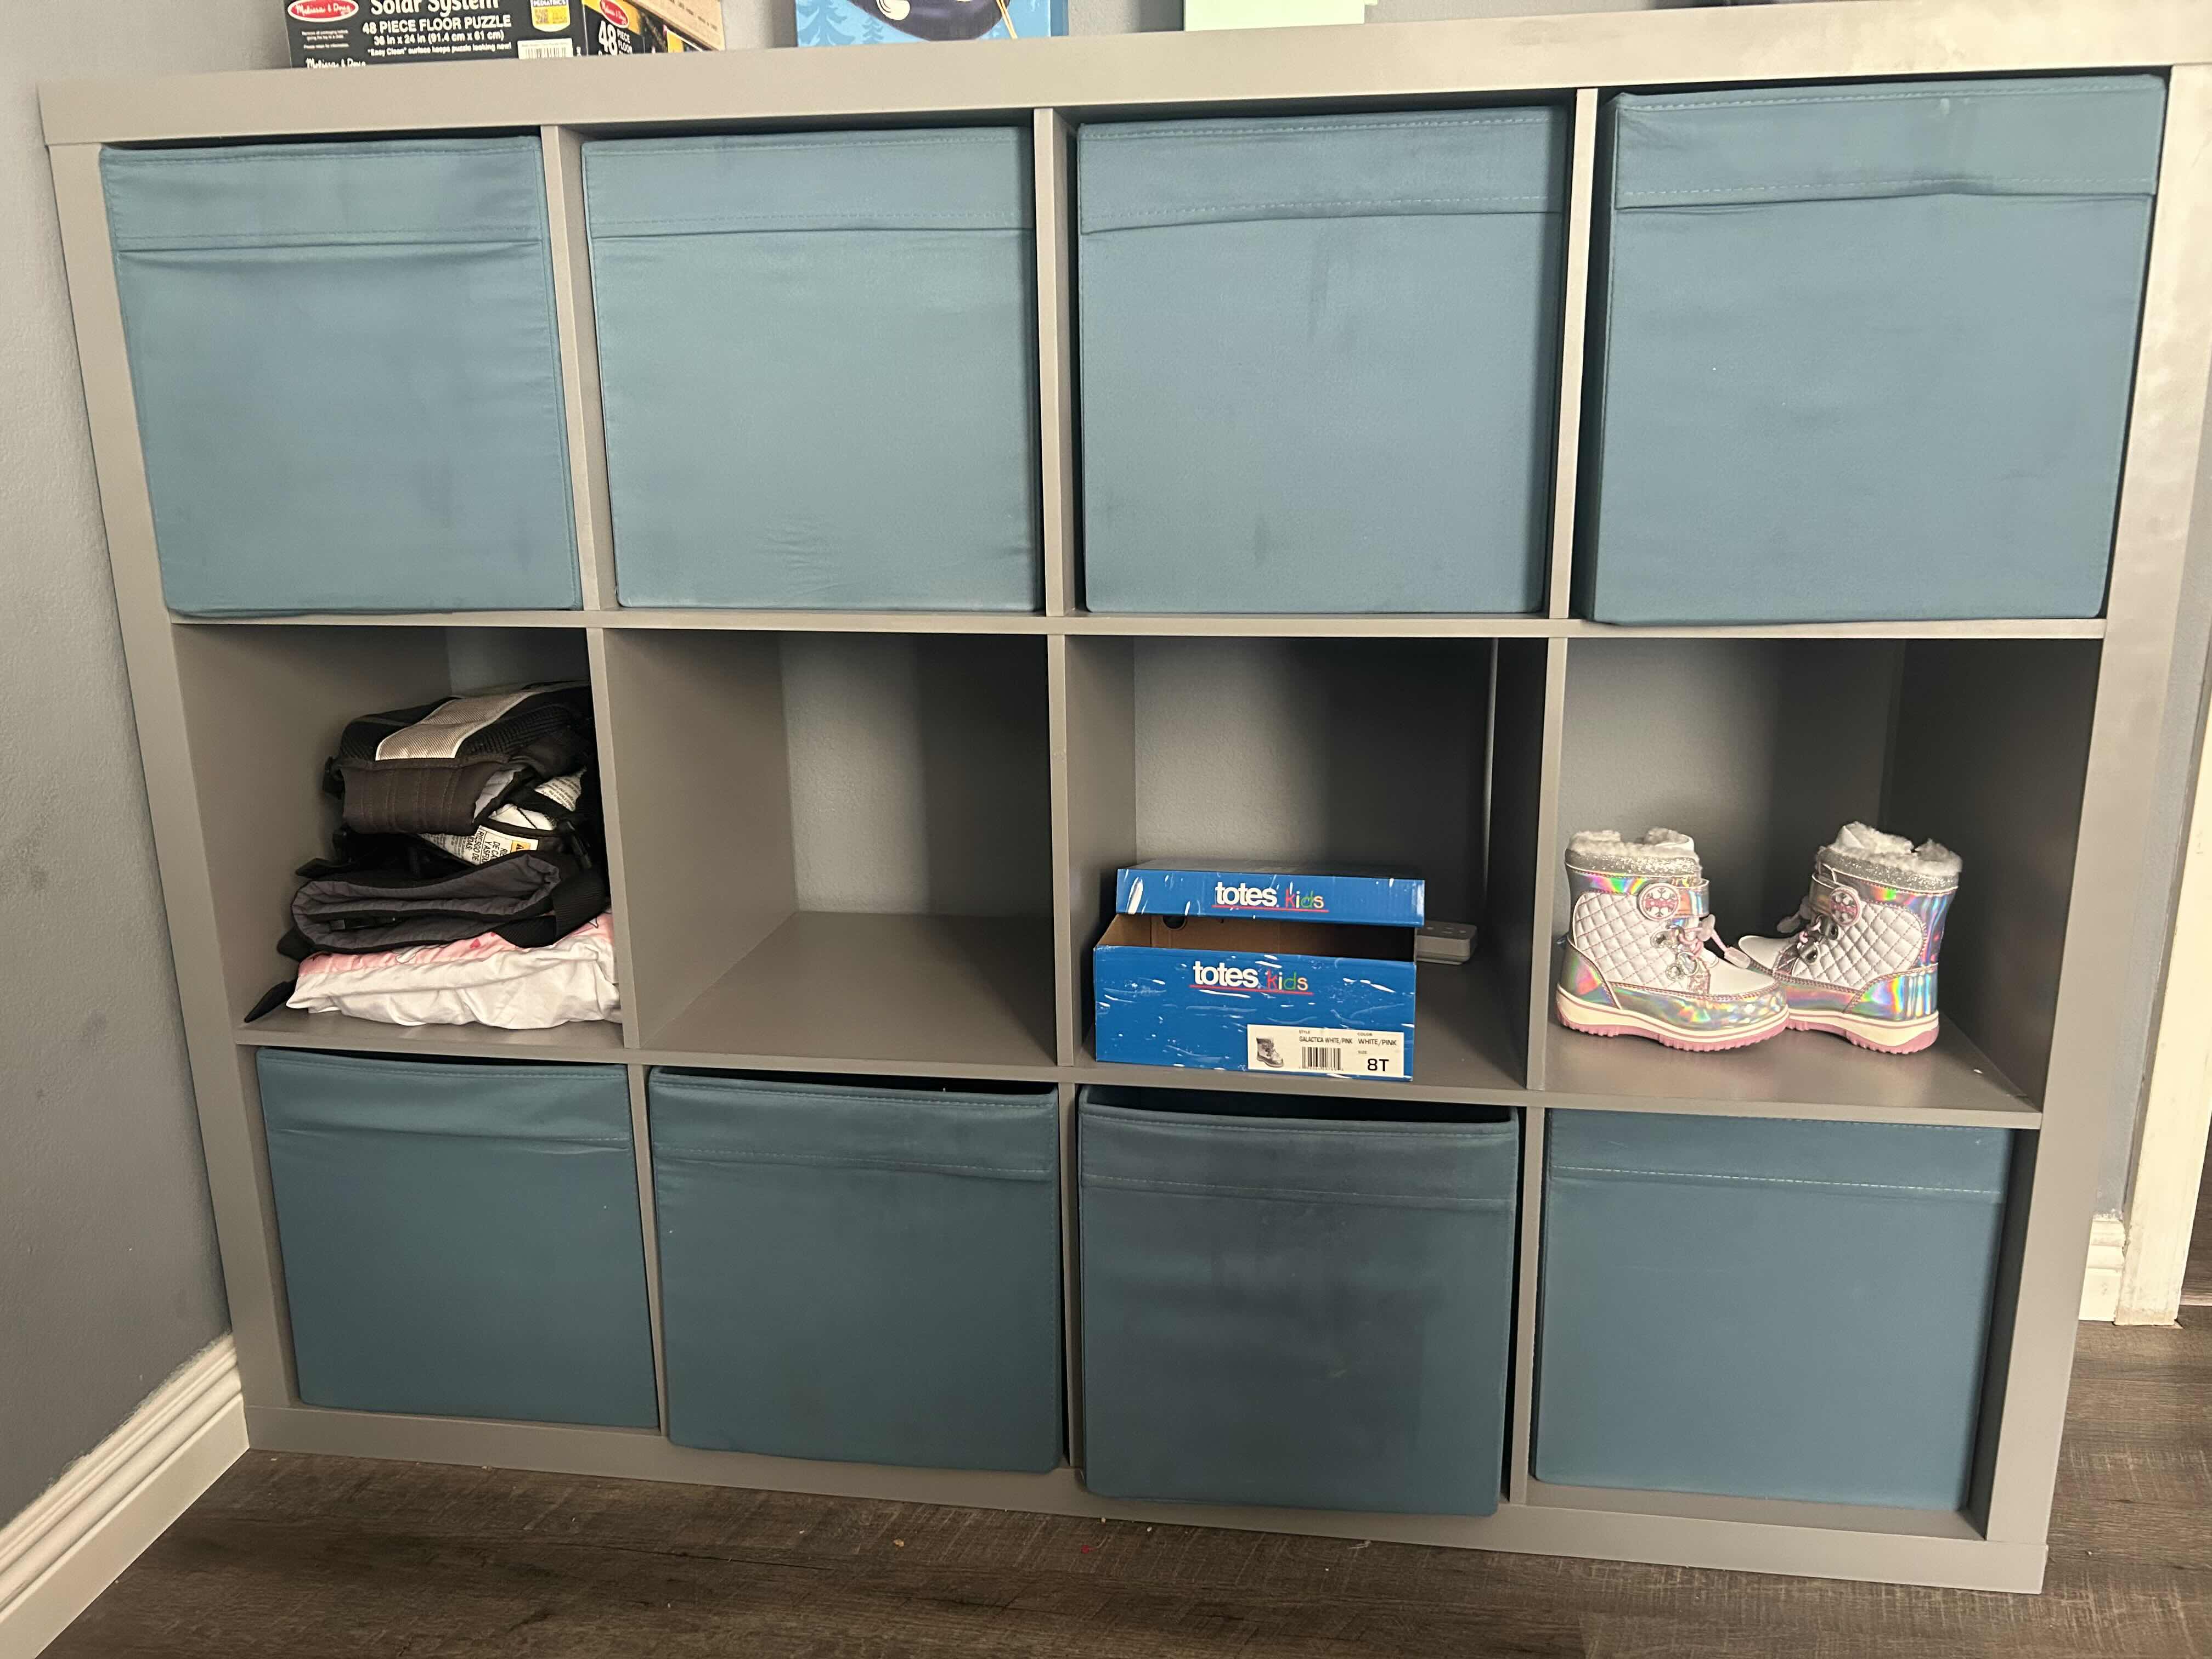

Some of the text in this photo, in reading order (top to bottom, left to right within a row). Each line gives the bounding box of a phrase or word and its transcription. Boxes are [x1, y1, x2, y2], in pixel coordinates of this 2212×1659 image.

[371, 0, 499, 17] Solar System
[362, 22, 377, 34] 48
[380, 19, 416, 33] PIECE
[419, 18, 461, 31] FLOOR
[464, 15, 512, 29] PUZZLE
[387, 35, 396, 44] in
[404, 33, 415, 44] 24
[417, 33, 426, 43] in
[427, 33, 450, 44] (91.4
[451, 33, 465, 41] cm
[474, 31, 484, 40] 61
[487, 30, 504, 41] cm)
[599, 20, 618, 55] 48
[617, 29, 630, 43] PIECE
[618, 40, 633, 54] FLOOR
[473, 831, 484, 853] RIESGO
[493, 841, 500, 850] DE
[1215, 882, 1324, 909] totes kids
[1193, 961, 1308, 991] totes kids
[1367, 1058, 1389, 1071] 8T
